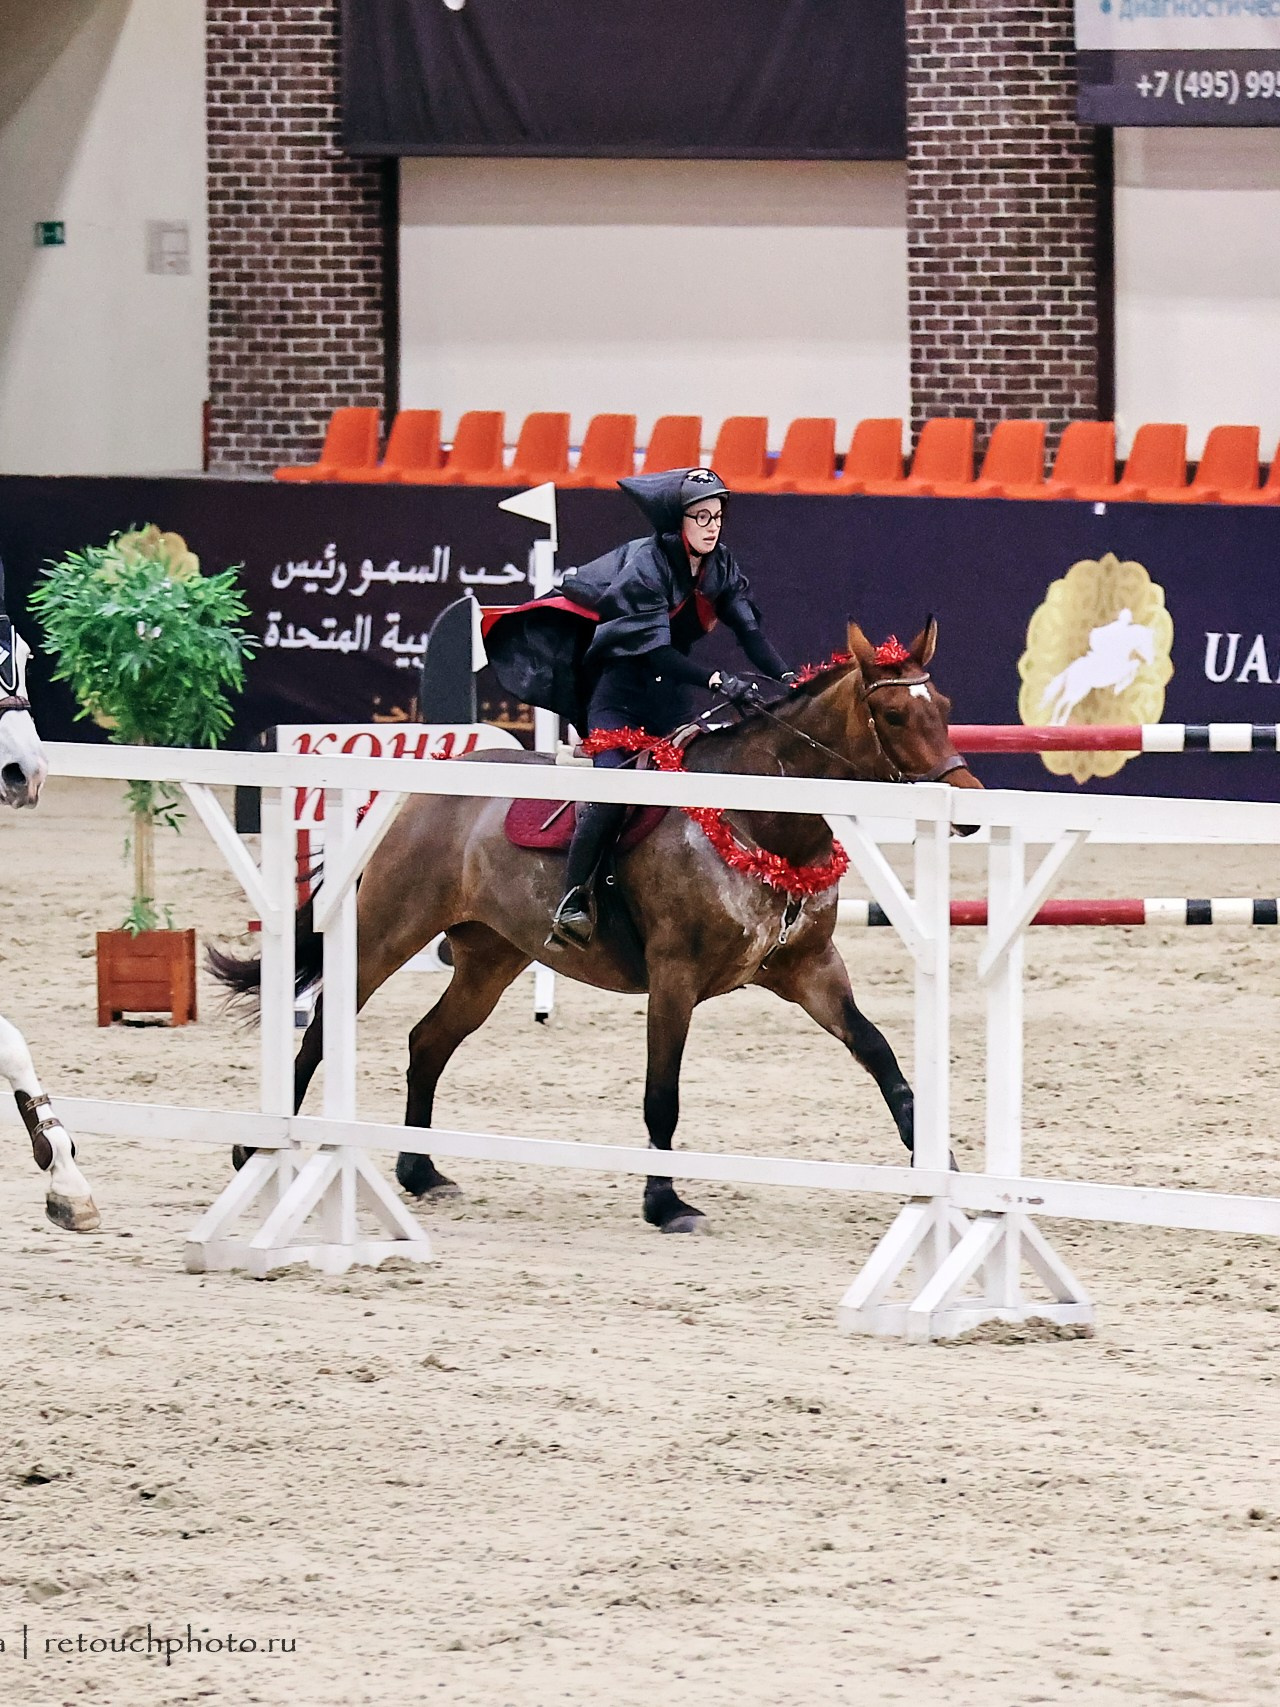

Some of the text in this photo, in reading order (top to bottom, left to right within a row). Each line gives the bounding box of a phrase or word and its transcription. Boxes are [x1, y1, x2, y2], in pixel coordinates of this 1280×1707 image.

[1136, 70, 1169, 98] +7
[1174, 69, 1240, 105] (495)
[271, 542, 348, 596] رئيس
[349, 545, 451, 597] السمو
[263, 610, 372, 654] المتحدة
[1204, 632, 1280, 684] UA
